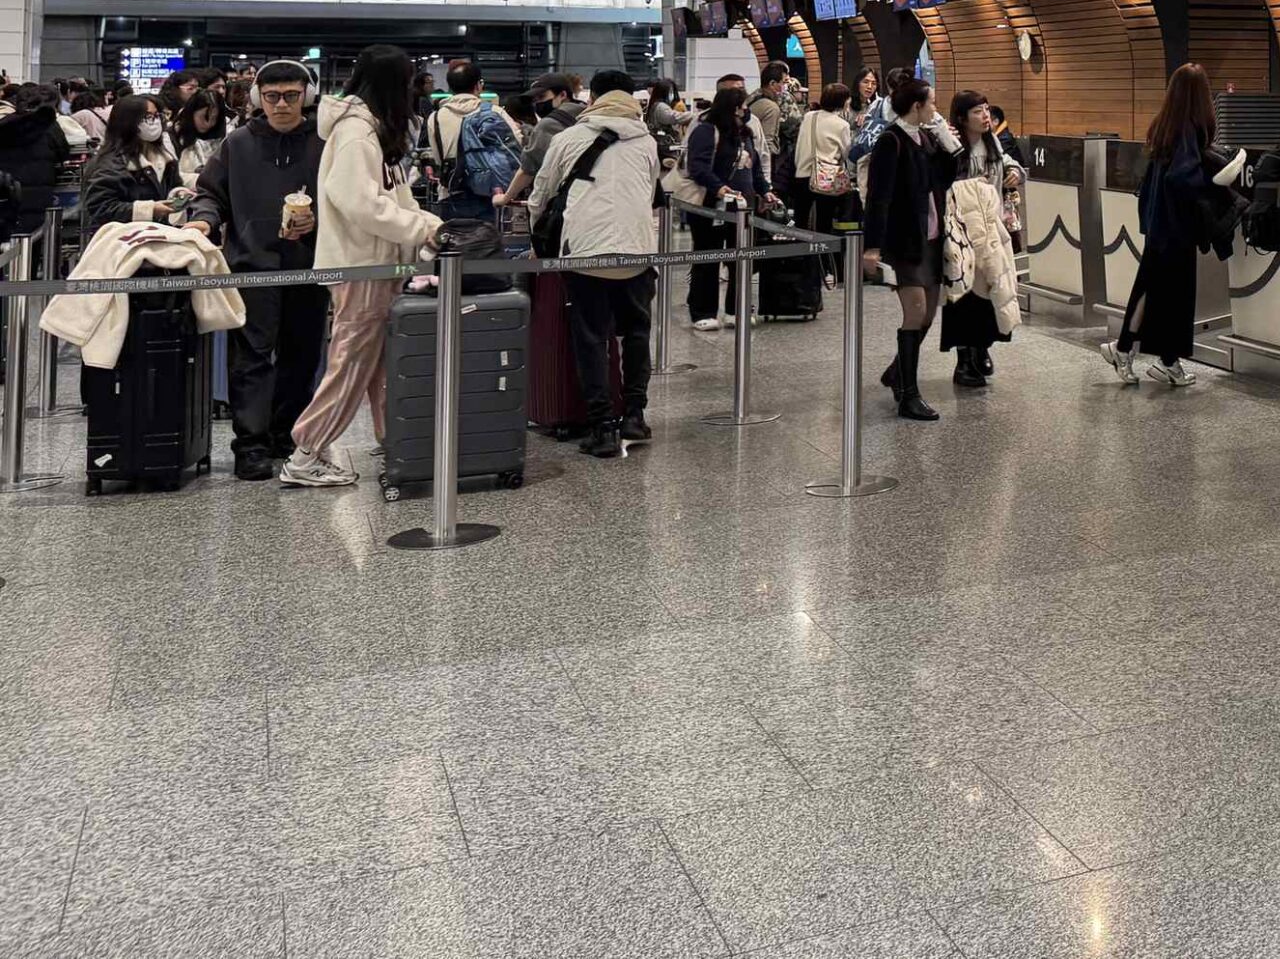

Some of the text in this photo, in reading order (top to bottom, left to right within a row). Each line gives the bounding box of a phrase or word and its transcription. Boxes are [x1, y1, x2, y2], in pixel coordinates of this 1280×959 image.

[1034, 147, 1045, 167] 14
[619, 255, 648, 266] Taiwan
[650, 253, 684, 266] Taoyuan
[685, 250, 736, 262] International
[738, 248, 767, 260] Airport
[161, 277, 196, 288] Taiwan
[200, 274, 242, 287] Taoyuan
[244, 272, 306, 284] International
[308, 270, 344, 283] Airport
